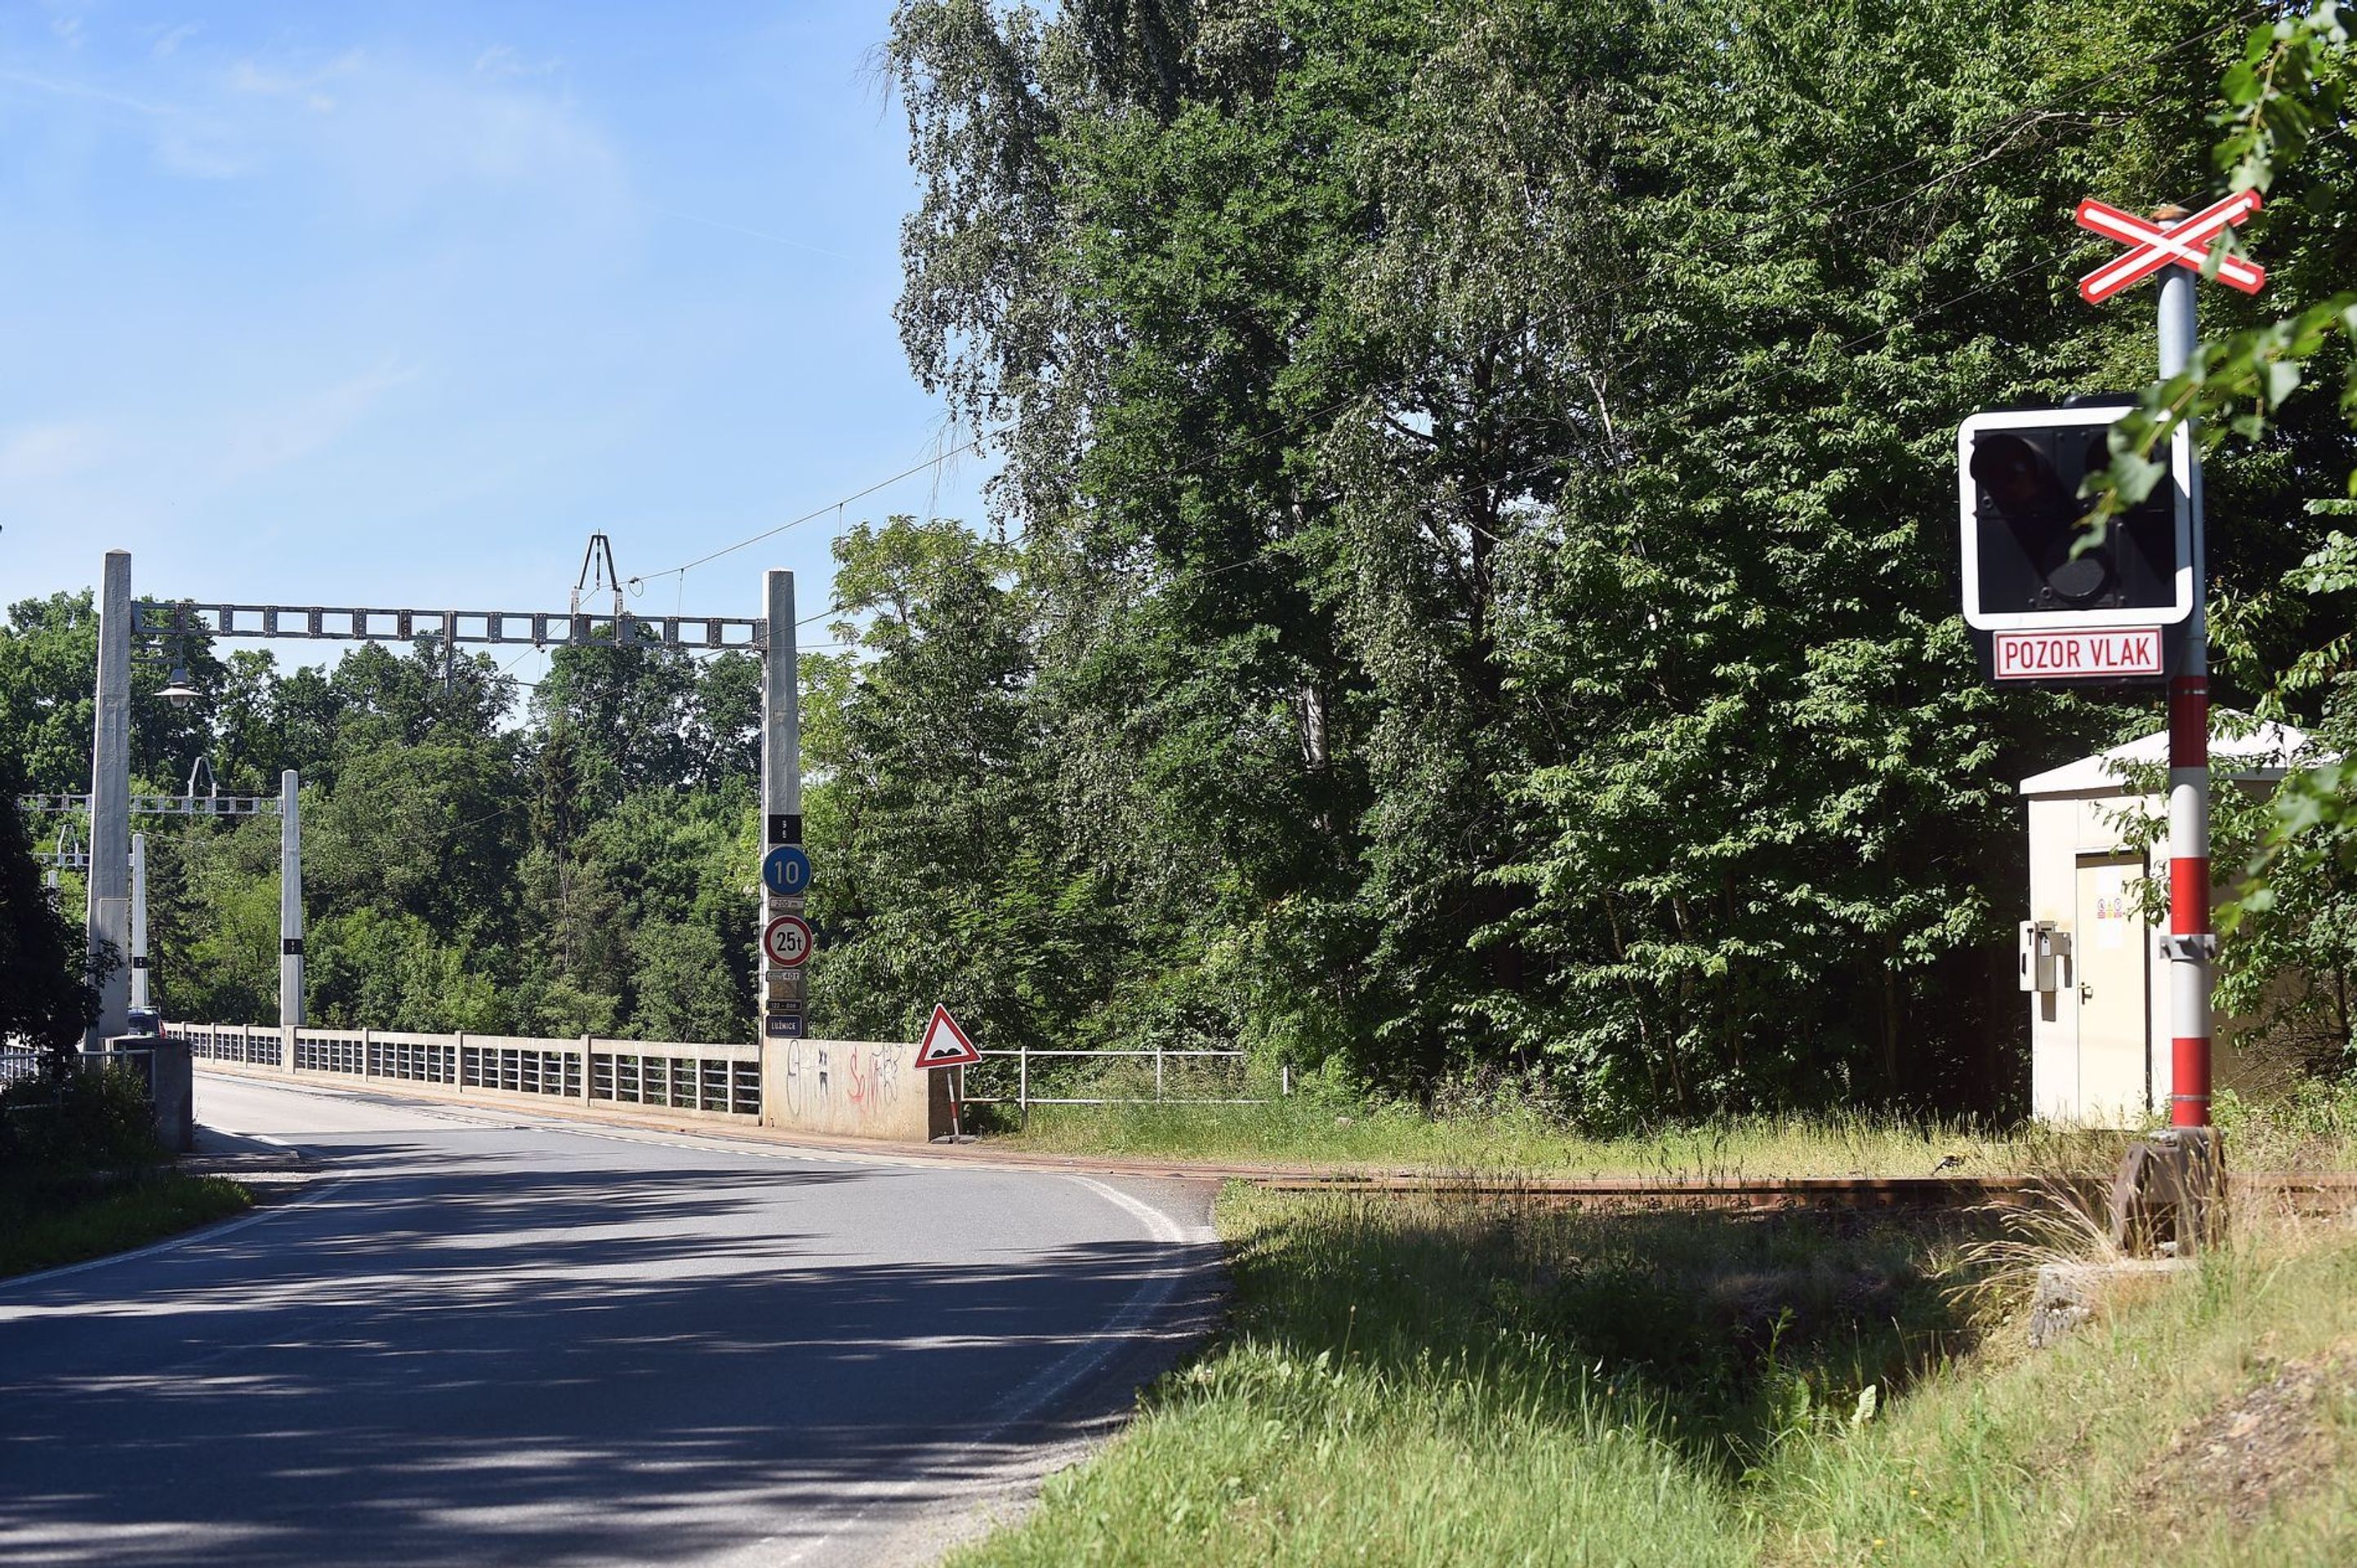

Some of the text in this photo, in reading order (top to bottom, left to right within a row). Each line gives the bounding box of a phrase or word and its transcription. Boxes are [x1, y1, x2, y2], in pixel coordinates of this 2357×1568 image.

[2005, 637, 2151, 670] POZOR VLAK
[774, 861, 799, 884] 10
[777, 931, 803, 951] 25t
